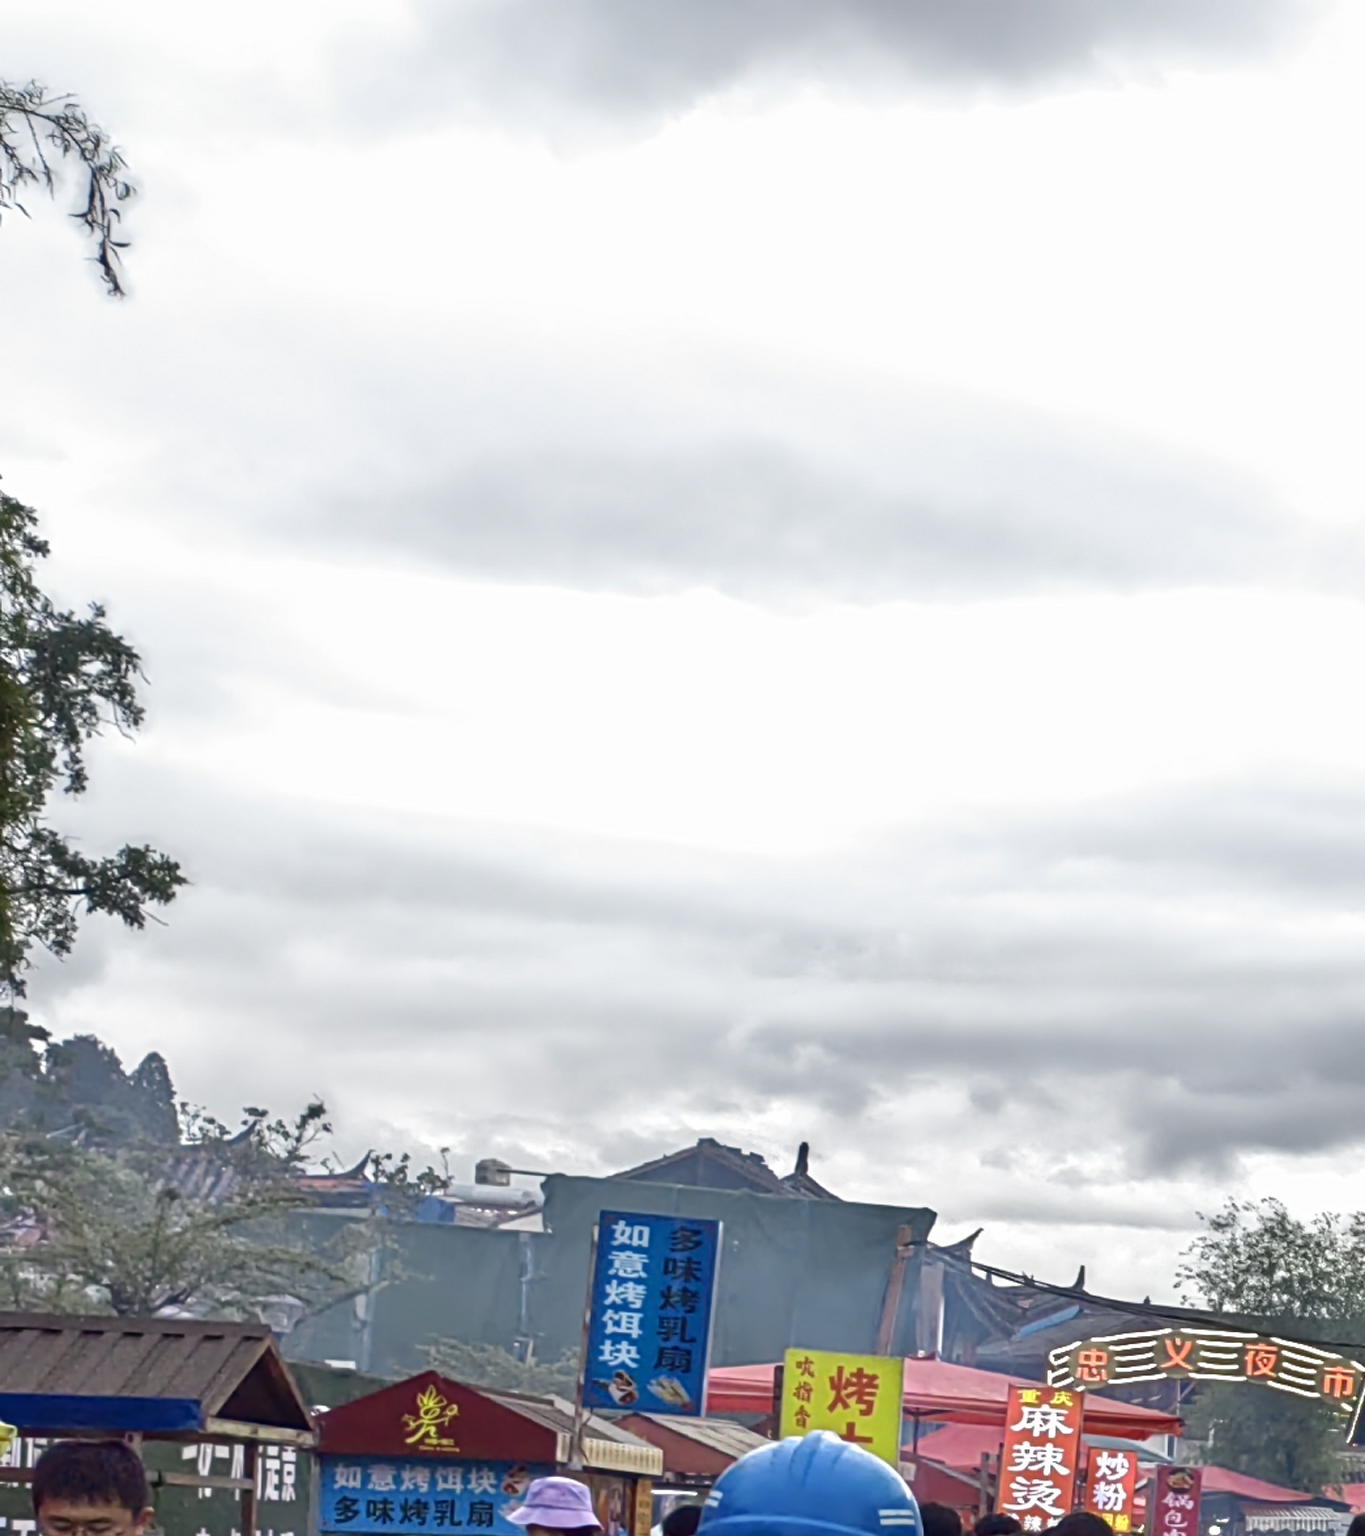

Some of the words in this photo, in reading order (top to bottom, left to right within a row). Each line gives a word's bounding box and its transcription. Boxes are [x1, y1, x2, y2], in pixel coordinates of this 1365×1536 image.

[599, 1220, 650, 1369] 如意烤饵块
[653, 1226, 703, 1375] 多味烤乳扇
[1017, 1388, 1074, 1407] 重庆
[1076, 1336, 1357, 1399] 忠义夜市
[333, 1463, 499, 1496] 如意烤饵块
[1002, 1404, 1074, 1516] 麻辣烫
[1093, 1451, 1130, 1512] 炒粉
[333, 1495, 495, 1528] 多味烤乳扇
